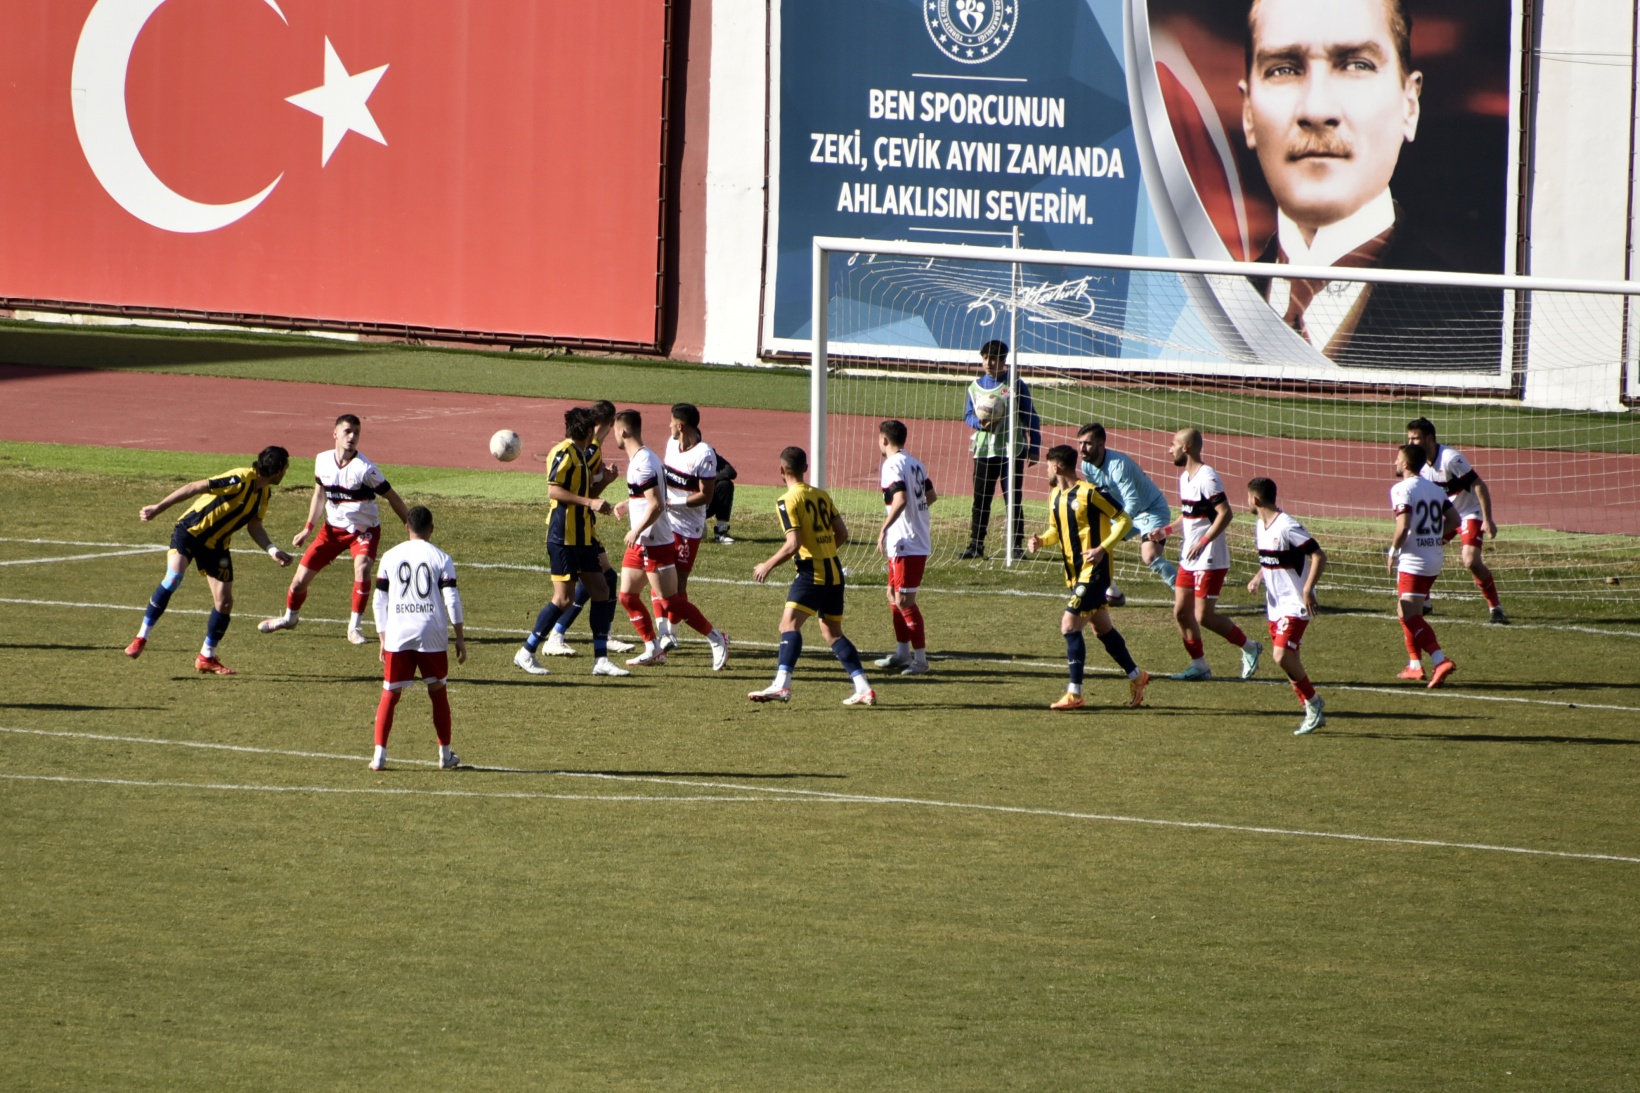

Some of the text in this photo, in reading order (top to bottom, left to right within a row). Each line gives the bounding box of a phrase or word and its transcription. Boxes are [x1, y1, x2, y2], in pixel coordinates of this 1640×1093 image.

[942, 17, 963, 42] TÜRKİYE
[869, 88, 1065, 128] BEN SPORCUNUN
[810, 129, 1125, 179] ZEKİ, ÇEVİK AYNI ZAMANDA
[837, 181, 1094, 225] AHLAKLISINI SEVERİM.
[804, 497, 831, 532] 26
[1416, 499, 1443, 535] 29
[1416, 538, 1434, 547] TANER
[218, 568, 230, 581] 70
[398, 561, 432, 599] 90
[1067, 594, 1082, 609] 20
